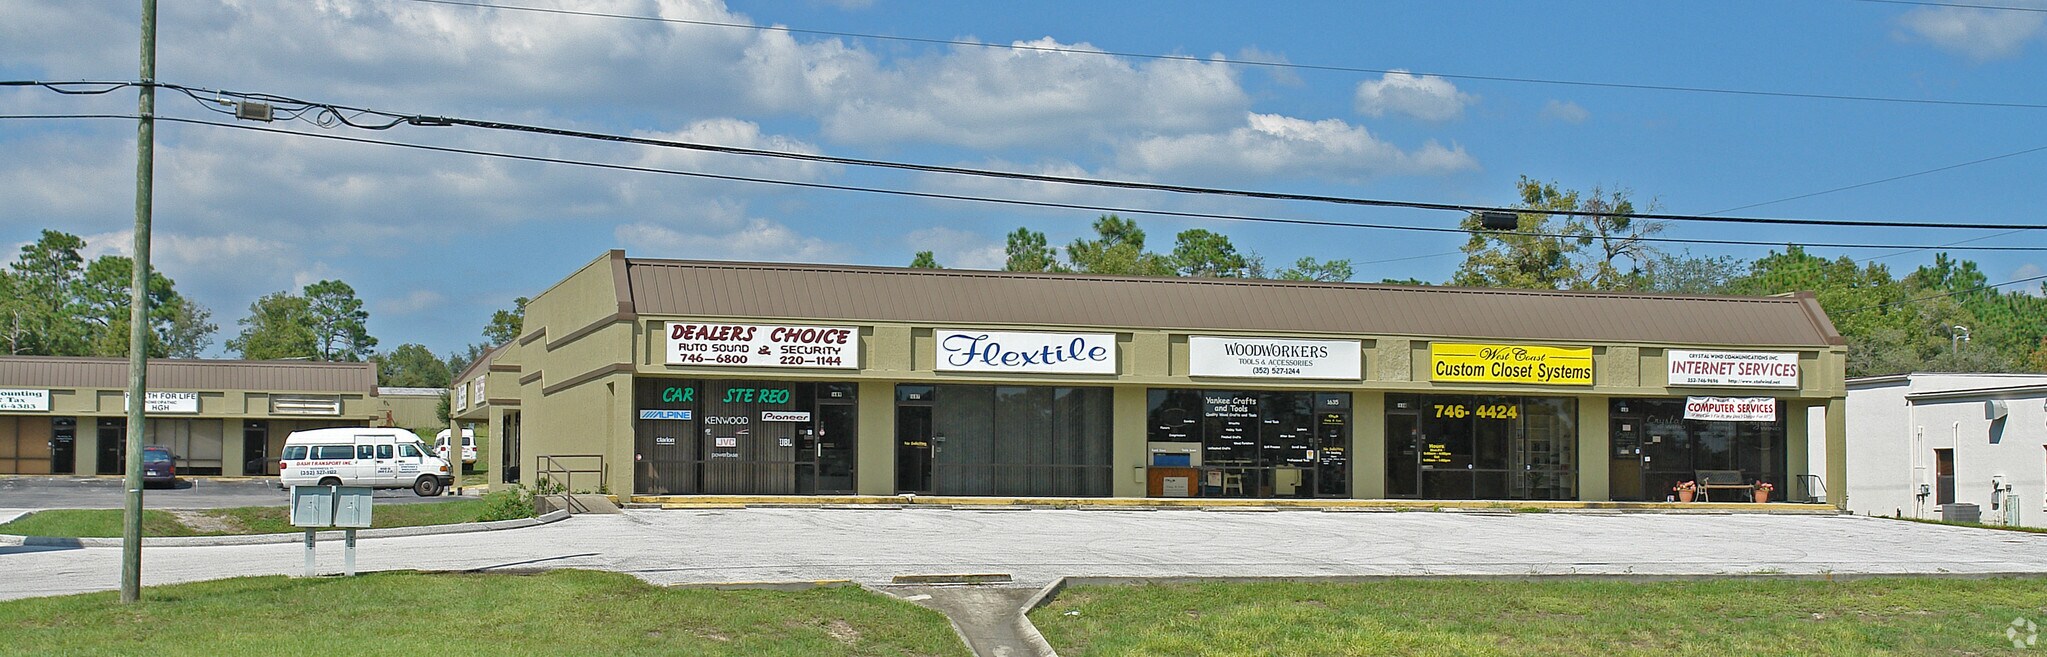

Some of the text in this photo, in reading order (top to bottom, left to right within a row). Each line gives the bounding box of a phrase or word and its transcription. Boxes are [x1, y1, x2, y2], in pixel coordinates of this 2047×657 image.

[671, 324, 851, 344] DEALERS CHOICE
[678, 343, 707, 352] AUTO
[712, 344, 749, 353] SOUND
[780, 345, 841, 355] SECURITY
[942, 334, 1107, 367] Flextile
[1224, 342, 1328, 358] WOODWORKERS
[1479, 347, 1546, 361] West Coast
[680, 354, 748, 363] 746-6800
[780, 356, 841, 366] 220-1144
[1252, 367, 1300, 375] (352) 527-1244
[1436, 360, 1591, 382] Custom Closet Systems
[1671, 360, 1797, 377] INTERNET SERVICES
[662, 387, 694, 402] CAR
[1205, 396, 1257, 405] Yankee Crafts
[1434, 404, 1518, 419] 746- 4424
[1687, 403, 1773, 413] COMPUTER SERVICES
[648, 411, 691, 419] ALPINE
[704, 416, 749, 425] KENWOOD
